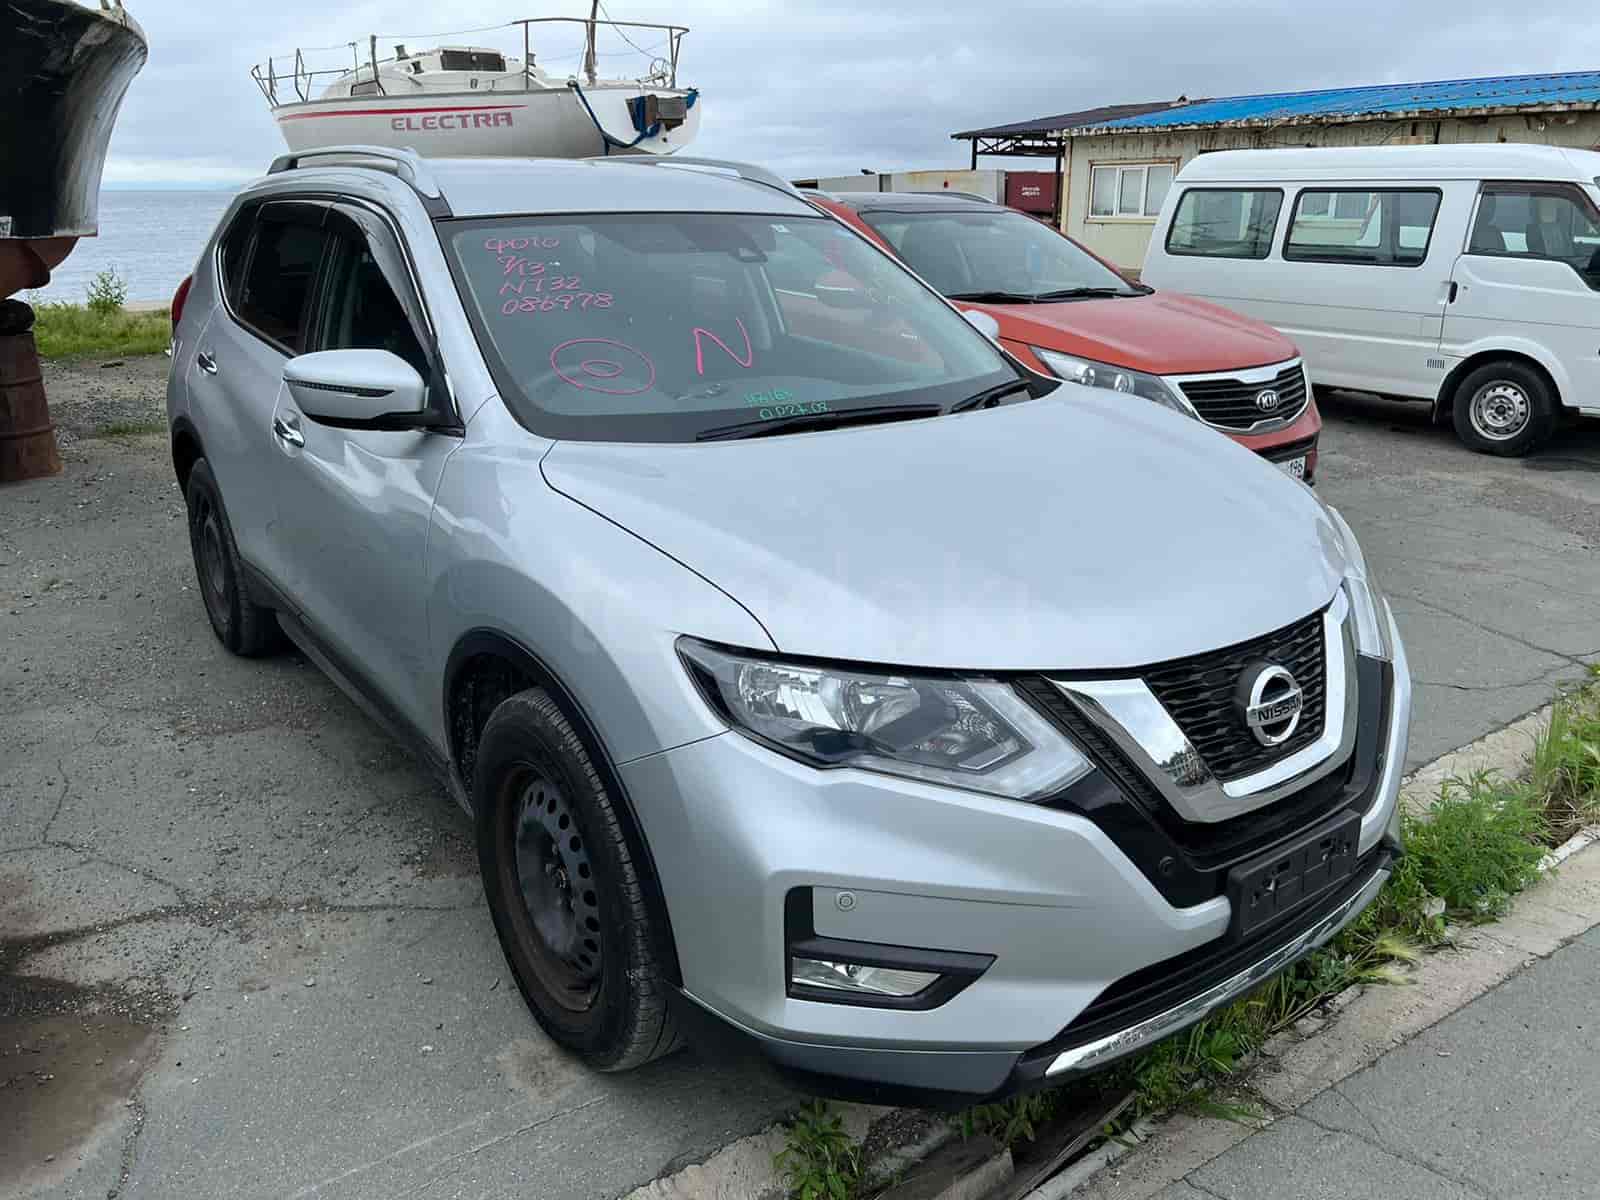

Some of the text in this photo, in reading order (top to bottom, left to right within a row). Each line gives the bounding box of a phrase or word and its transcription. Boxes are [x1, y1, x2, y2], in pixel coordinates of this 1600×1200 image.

[391, 111, 513, 131] ELECTRA
[692, 316, 753, 376] N
[1262, 394, 1278, 409] KIA
[1257, 702, 1299, 721] NISSA
